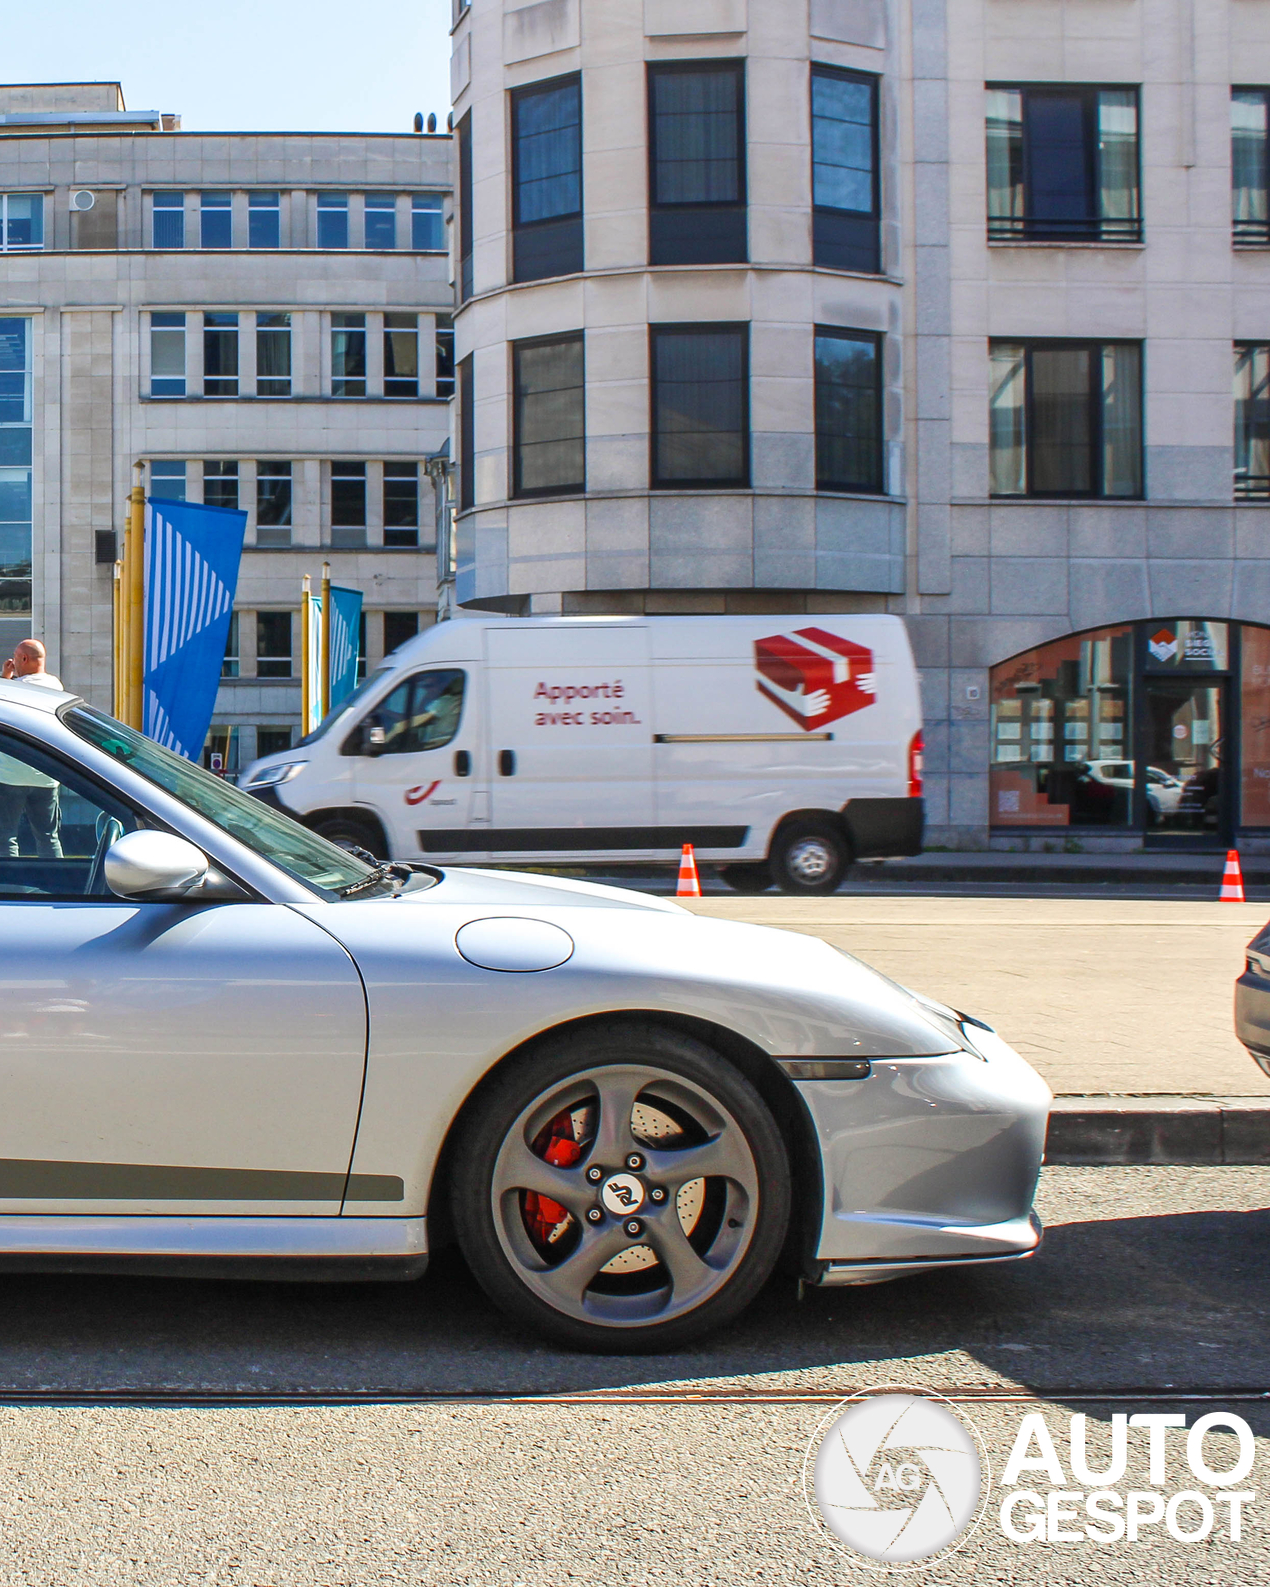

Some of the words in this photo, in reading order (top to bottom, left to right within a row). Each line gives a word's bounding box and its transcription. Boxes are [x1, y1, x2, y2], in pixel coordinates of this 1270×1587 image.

[533, 679, 625, 705] Apporté
[534, 711, 585, 726] avec
[589, 706, 642, 726] soin.
